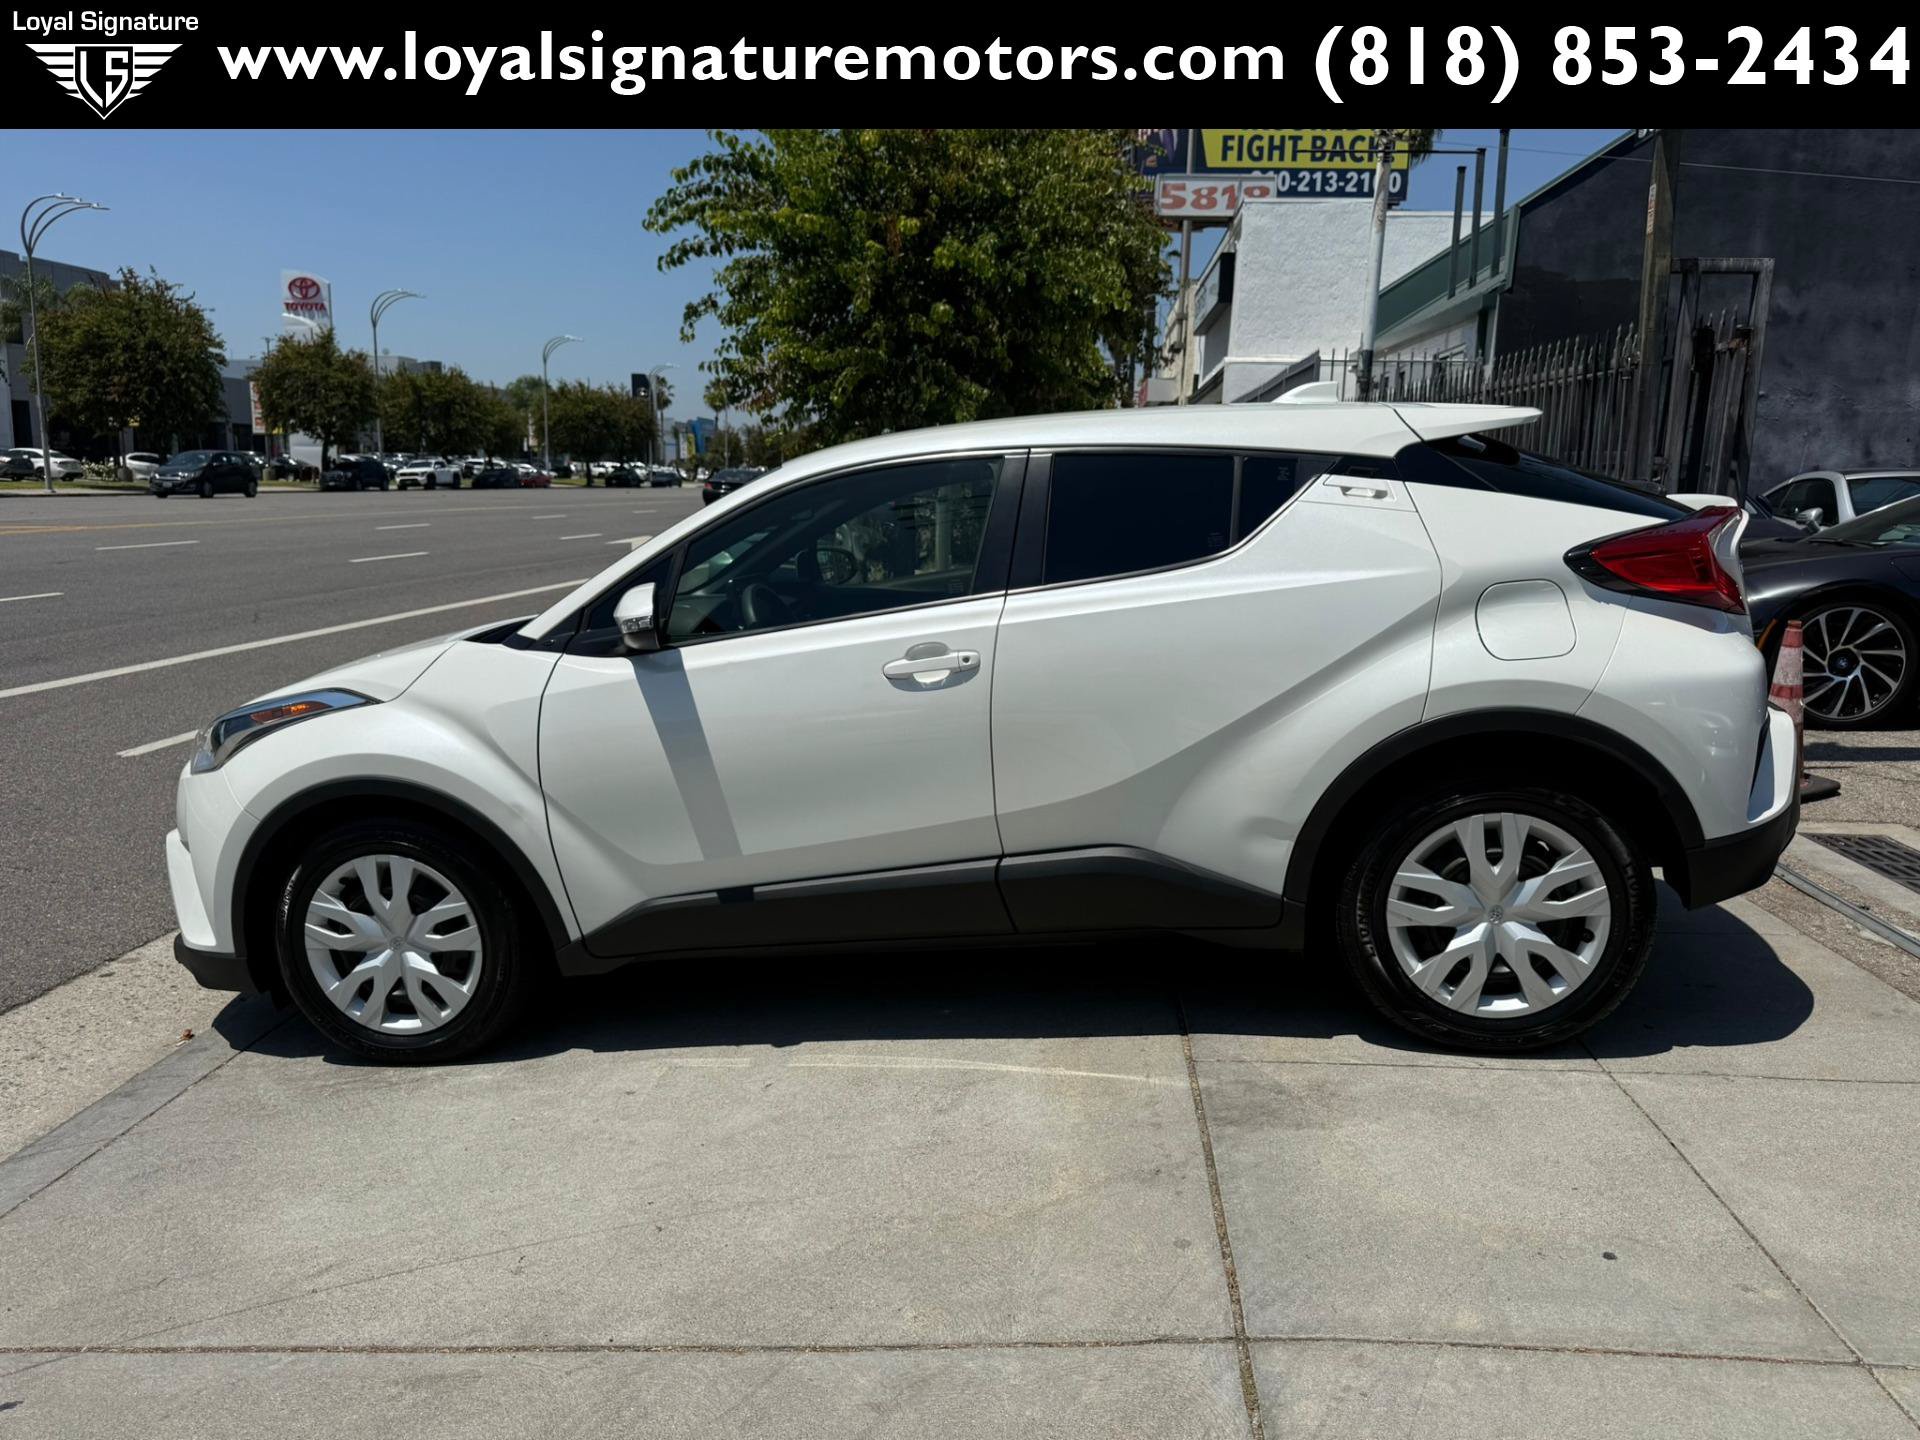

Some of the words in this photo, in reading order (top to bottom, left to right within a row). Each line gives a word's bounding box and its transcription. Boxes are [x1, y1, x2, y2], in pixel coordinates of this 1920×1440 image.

[1221, 134, 1303, 162] FIGHT
[1251, 171, 1402, 193] 0-213-210
[283, 301, 327, 312] TOYOTA
